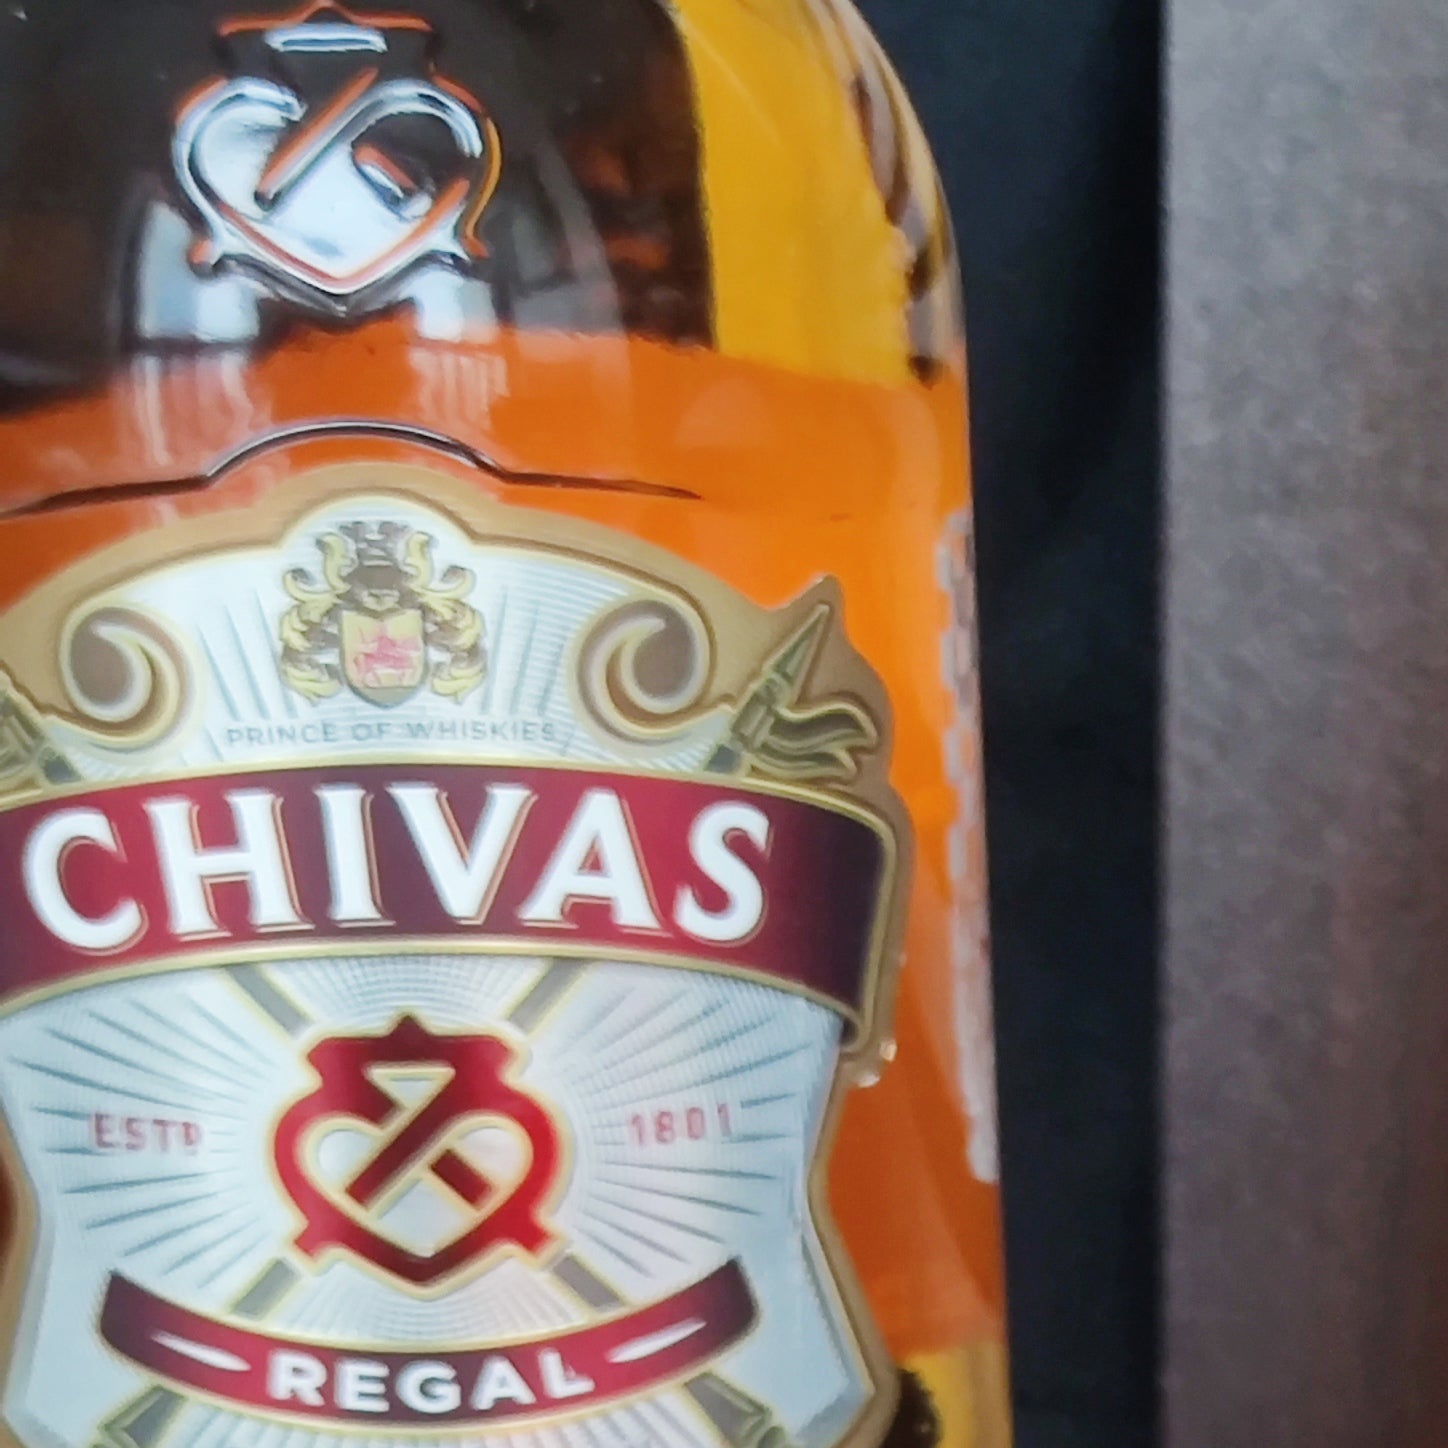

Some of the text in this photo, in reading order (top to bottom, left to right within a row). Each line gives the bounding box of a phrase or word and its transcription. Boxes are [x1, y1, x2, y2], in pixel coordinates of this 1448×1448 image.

[226, 718, 555, 748] PRINCE OF WHISKIES
[23, 782, 773, 951] CHIVAS
[629, 1102, 733, 1147] 1801
[266, 1346, 596, 1415] REGAL
